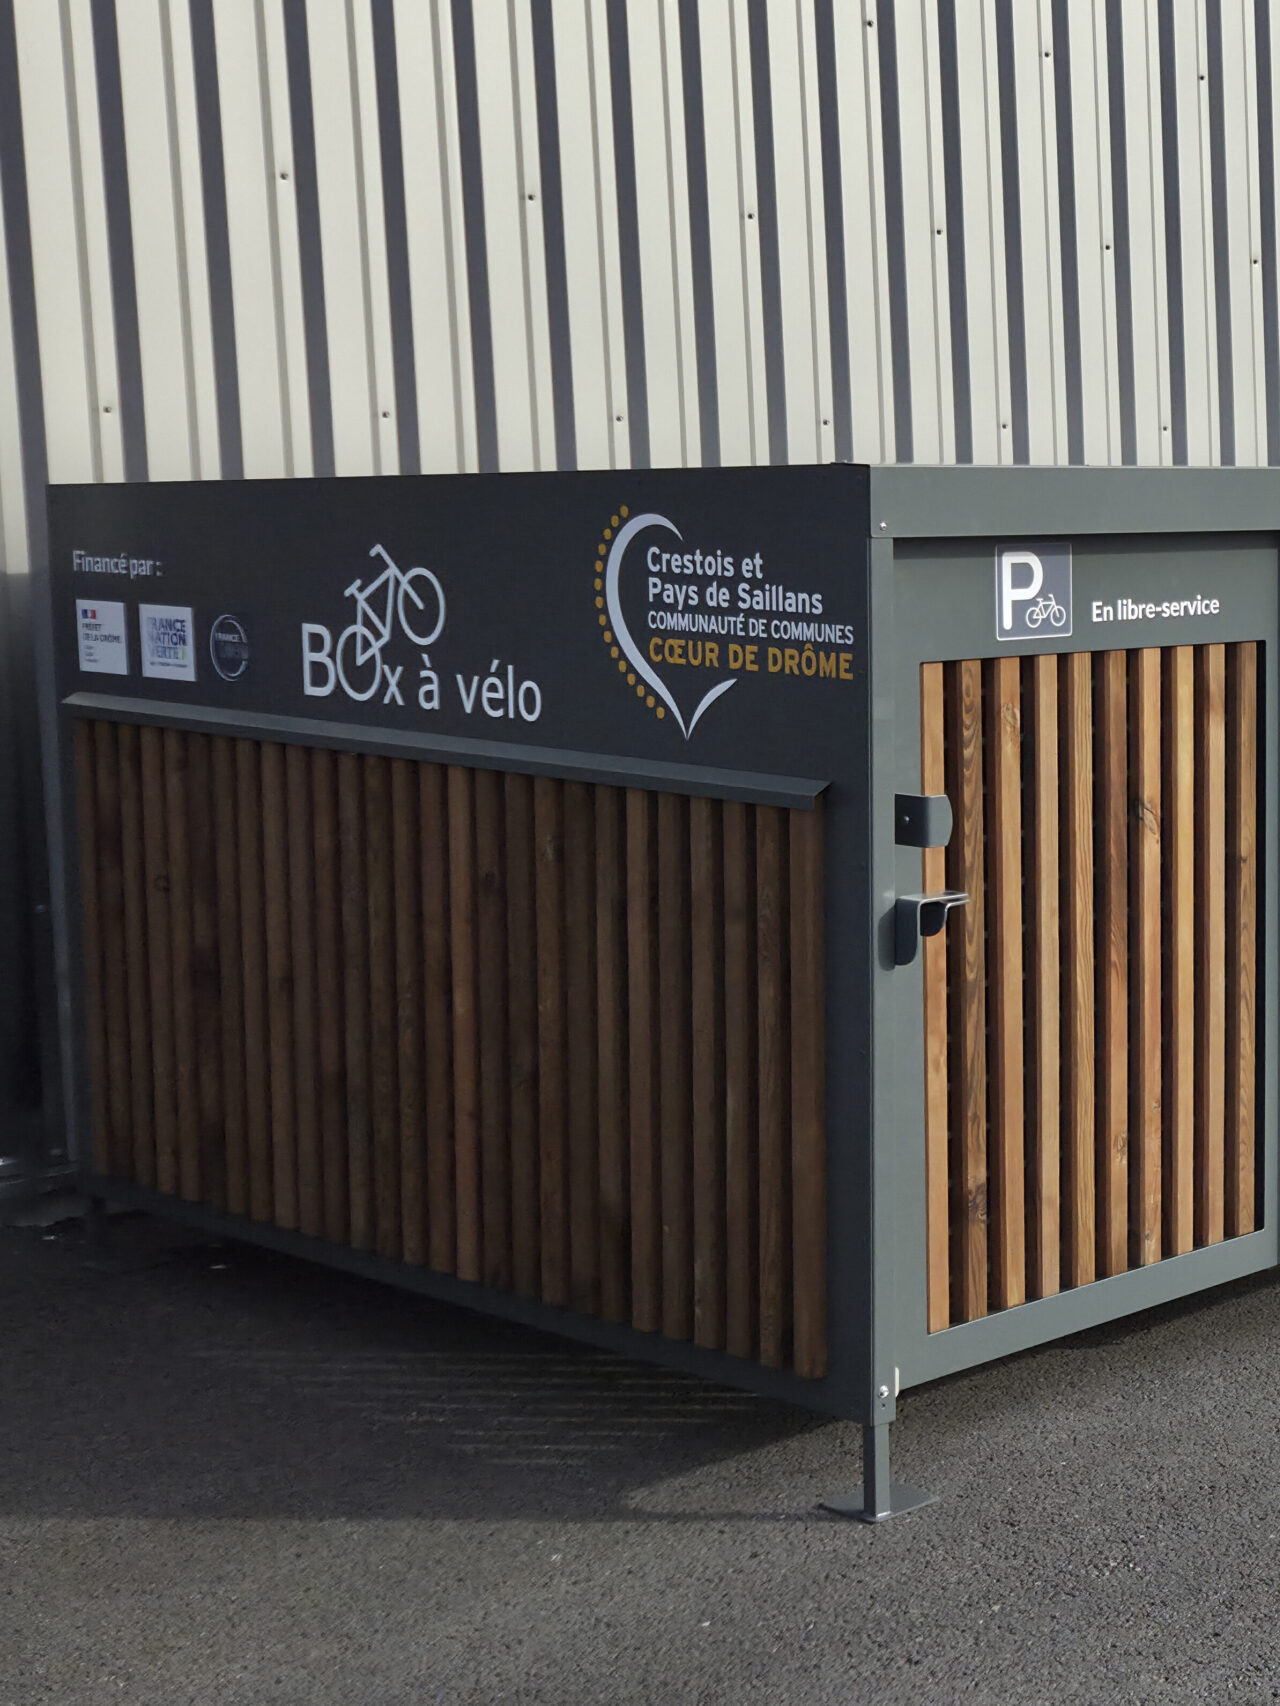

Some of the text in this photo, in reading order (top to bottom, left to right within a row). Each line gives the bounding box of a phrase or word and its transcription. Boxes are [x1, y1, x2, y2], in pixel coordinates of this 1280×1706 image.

[72, 550, 128, 574] Financé
[647, 546, 764, 579] Crestois et
[648, 577, 823, 615] Pays de Saillans
[1002, 551, 1043, 630] P
[1092, 595, 1220, 622] En libre-service
[648, 610, 854, 645] COMMUNAUTÉ DE COMMUNES
[649, 637, 854, 680] CŒUR DE DRÔME
[418, 653, 440, 710] à
[456, 659, 542, 722] vélo
